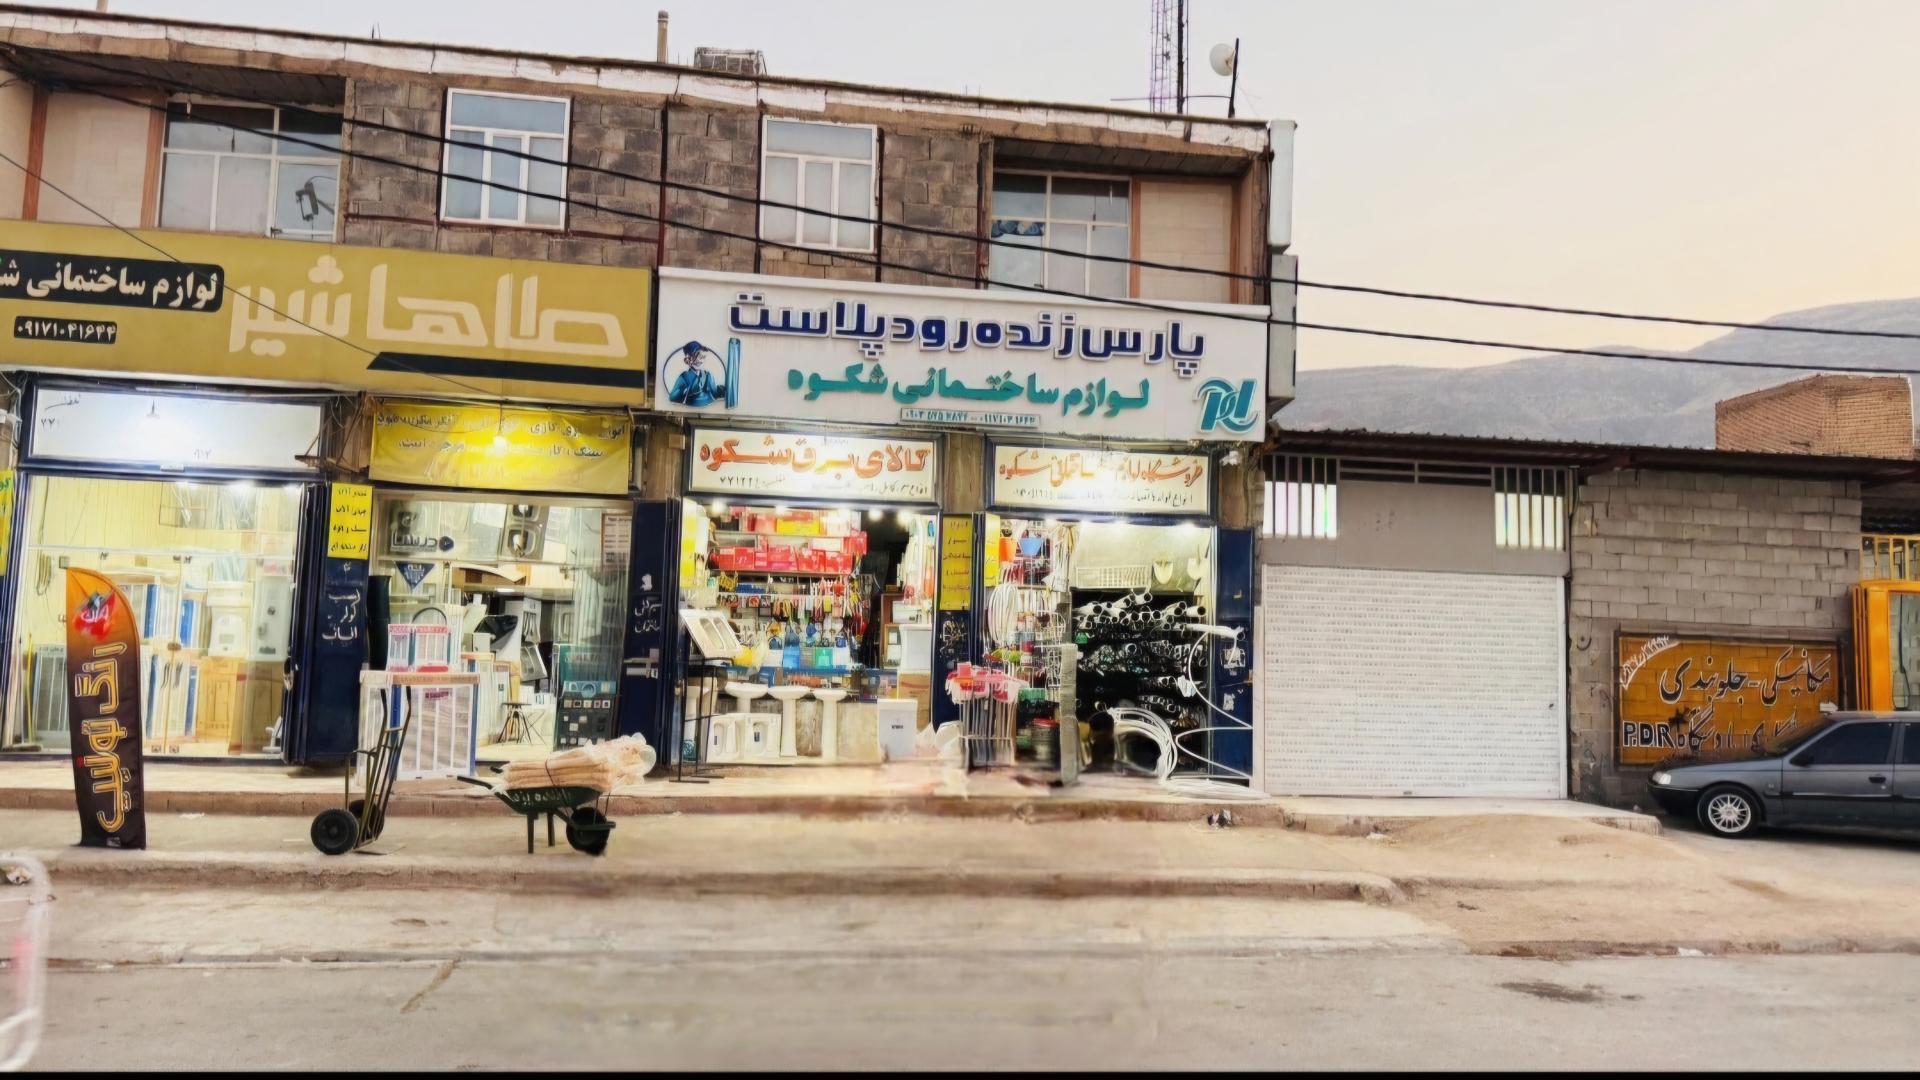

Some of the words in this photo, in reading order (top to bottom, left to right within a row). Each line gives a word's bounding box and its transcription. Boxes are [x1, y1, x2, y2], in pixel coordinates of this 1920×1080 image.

[26, 261, 146, 298] ساختمانی
[152, 271, 218, 309] لوازم
[229, 254, 353, 357] شیر
[727, 293, 889, 359] پلاست
[17, 321, 117, 342] ۰۹۱۷۱۰۴۱۶۴۴
[891, 317, 970, 352] رود
[971, 311, 1077, 358] زنده
[1080, 320, 1207, 378] پارس
[787, 362, 887, 403] شکوه
[891, 366, 1060, 405] ساختمانی
[1062, 378, 1151, 418] لوازم
[699, 435, 791, 472] شکوه
[791, 437, 855, 480] برق
[853, 443, 931, 479] کالای
[998, 449, 1052, 480] شکوه
[75, 642, 127, 714] رنگ
[1659, 655, 1748, 705] جلوبندی
[1760, 645, 1832, 707] مکانیکی
[75, 717, 132, 833] تولیپ
